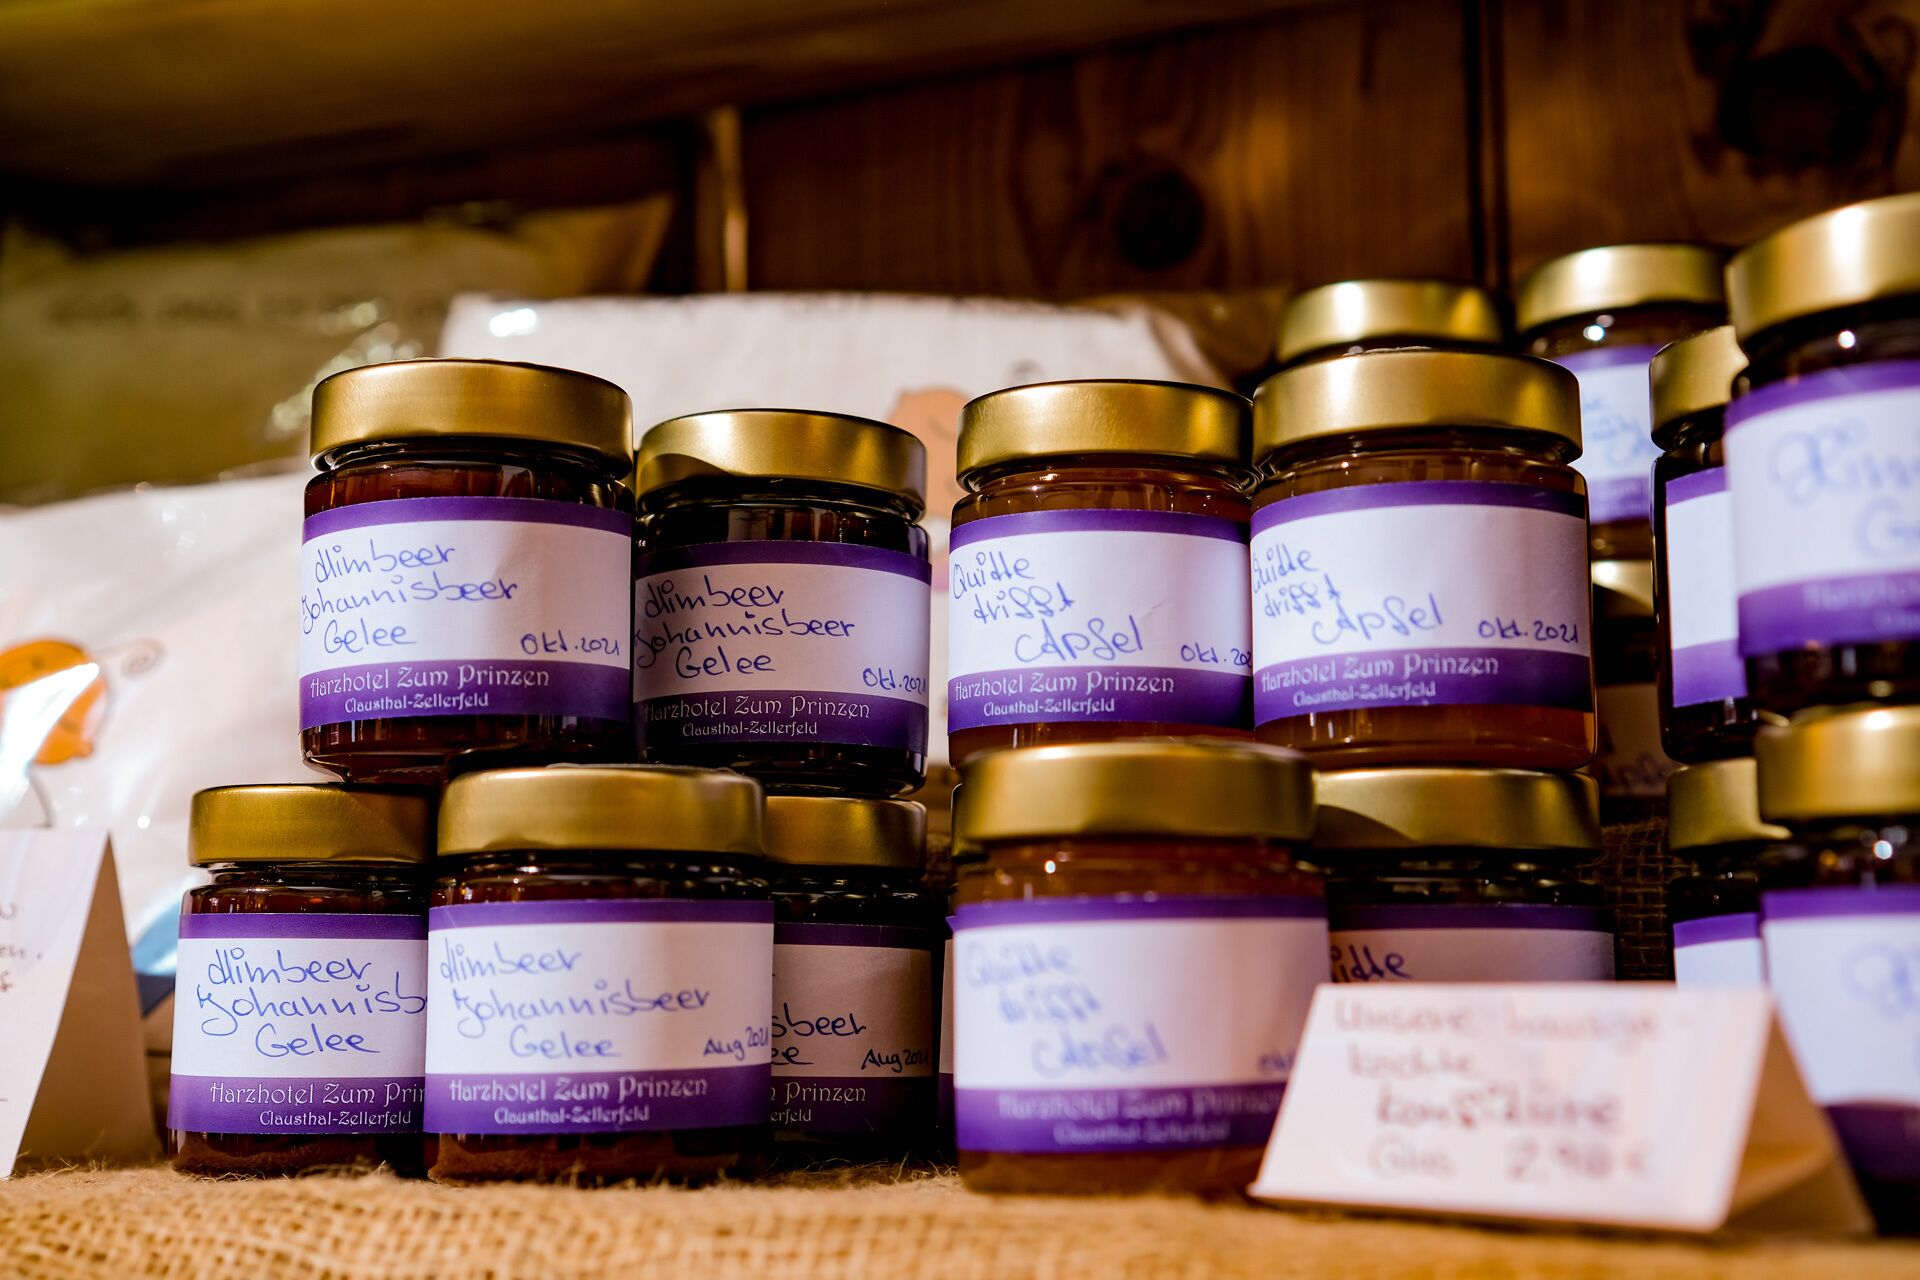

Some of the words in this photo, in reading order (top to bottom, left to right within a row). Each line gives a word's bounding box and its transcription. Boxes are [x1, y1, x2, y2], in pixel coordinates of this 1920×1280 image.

[315, 539, 455, 583] Himbeer
[952, 551, 1036, 600] Quitte
[302, 571, 517, 634] Johannisbeer
[645, 574, 784, 618] Himbeer
[973, 582, 1075, 624] trifft
[324, 618, 417, 653] Gelee
[1312, 593, 1443, 645] Apfel
[635, 608, 856, 669] Johannisbeer
[1015, 614, 1143, 662] Apfel
[676, 646, 776, 678] Gelee
[1262, 661, 1337, 693] Harzhotel
[1343, 656, 1395, 680] Zum
[1404, 653, 1499, 679] Prinzen
[310, 665, 389, 698] Harzhotel
[398, 667, 449, 689] Zum
[458, 663, 549, 690] Prinzen
[955, 675, 1023, 701] Harzhotel
[1030, 672, 1077, 693] Zum
[1086, 670, 1175, 695] Prinzen
[1293, 681, 1437, 708] Clausthal-Zellerfeld
[345, 691, 489, 714] Clausthal-Zellerfeld
[643, 696, 727, 723] Harzhotel
[734, 694, 782, 715] Zum
[790, 696, 871, 719] Prinzen
[984, 698, 1115, 717] Clausthal-Zellerfeld
[682, 720, 818, 738] Clausthal-Zellerfeld
[208, 947, 372, 985] Himbeer
[440, 937, 582, 983] Himbeer
[452, 979, 710, 1039] Johannisbeer
[255, 1023, 380, 1058] Gelee
[509, 1023, 622, 1059] Gelee
[210, 1083, 314, 1107] Harzhotel
[323, 1084, 375, 1104] Zum
[450, 1079, 546, 1103] Harzhotel
[555, 1076, 609, 1101] Zum
[618, 1075, 708, 1103] Prinzen
[785, 1081, 867, 1105] Prinzen
[259, 1110, 412, 1128] Clausthal-Zellerfeld
[494, 1107, 650, 1125] Clausthal-Zellerfeld
